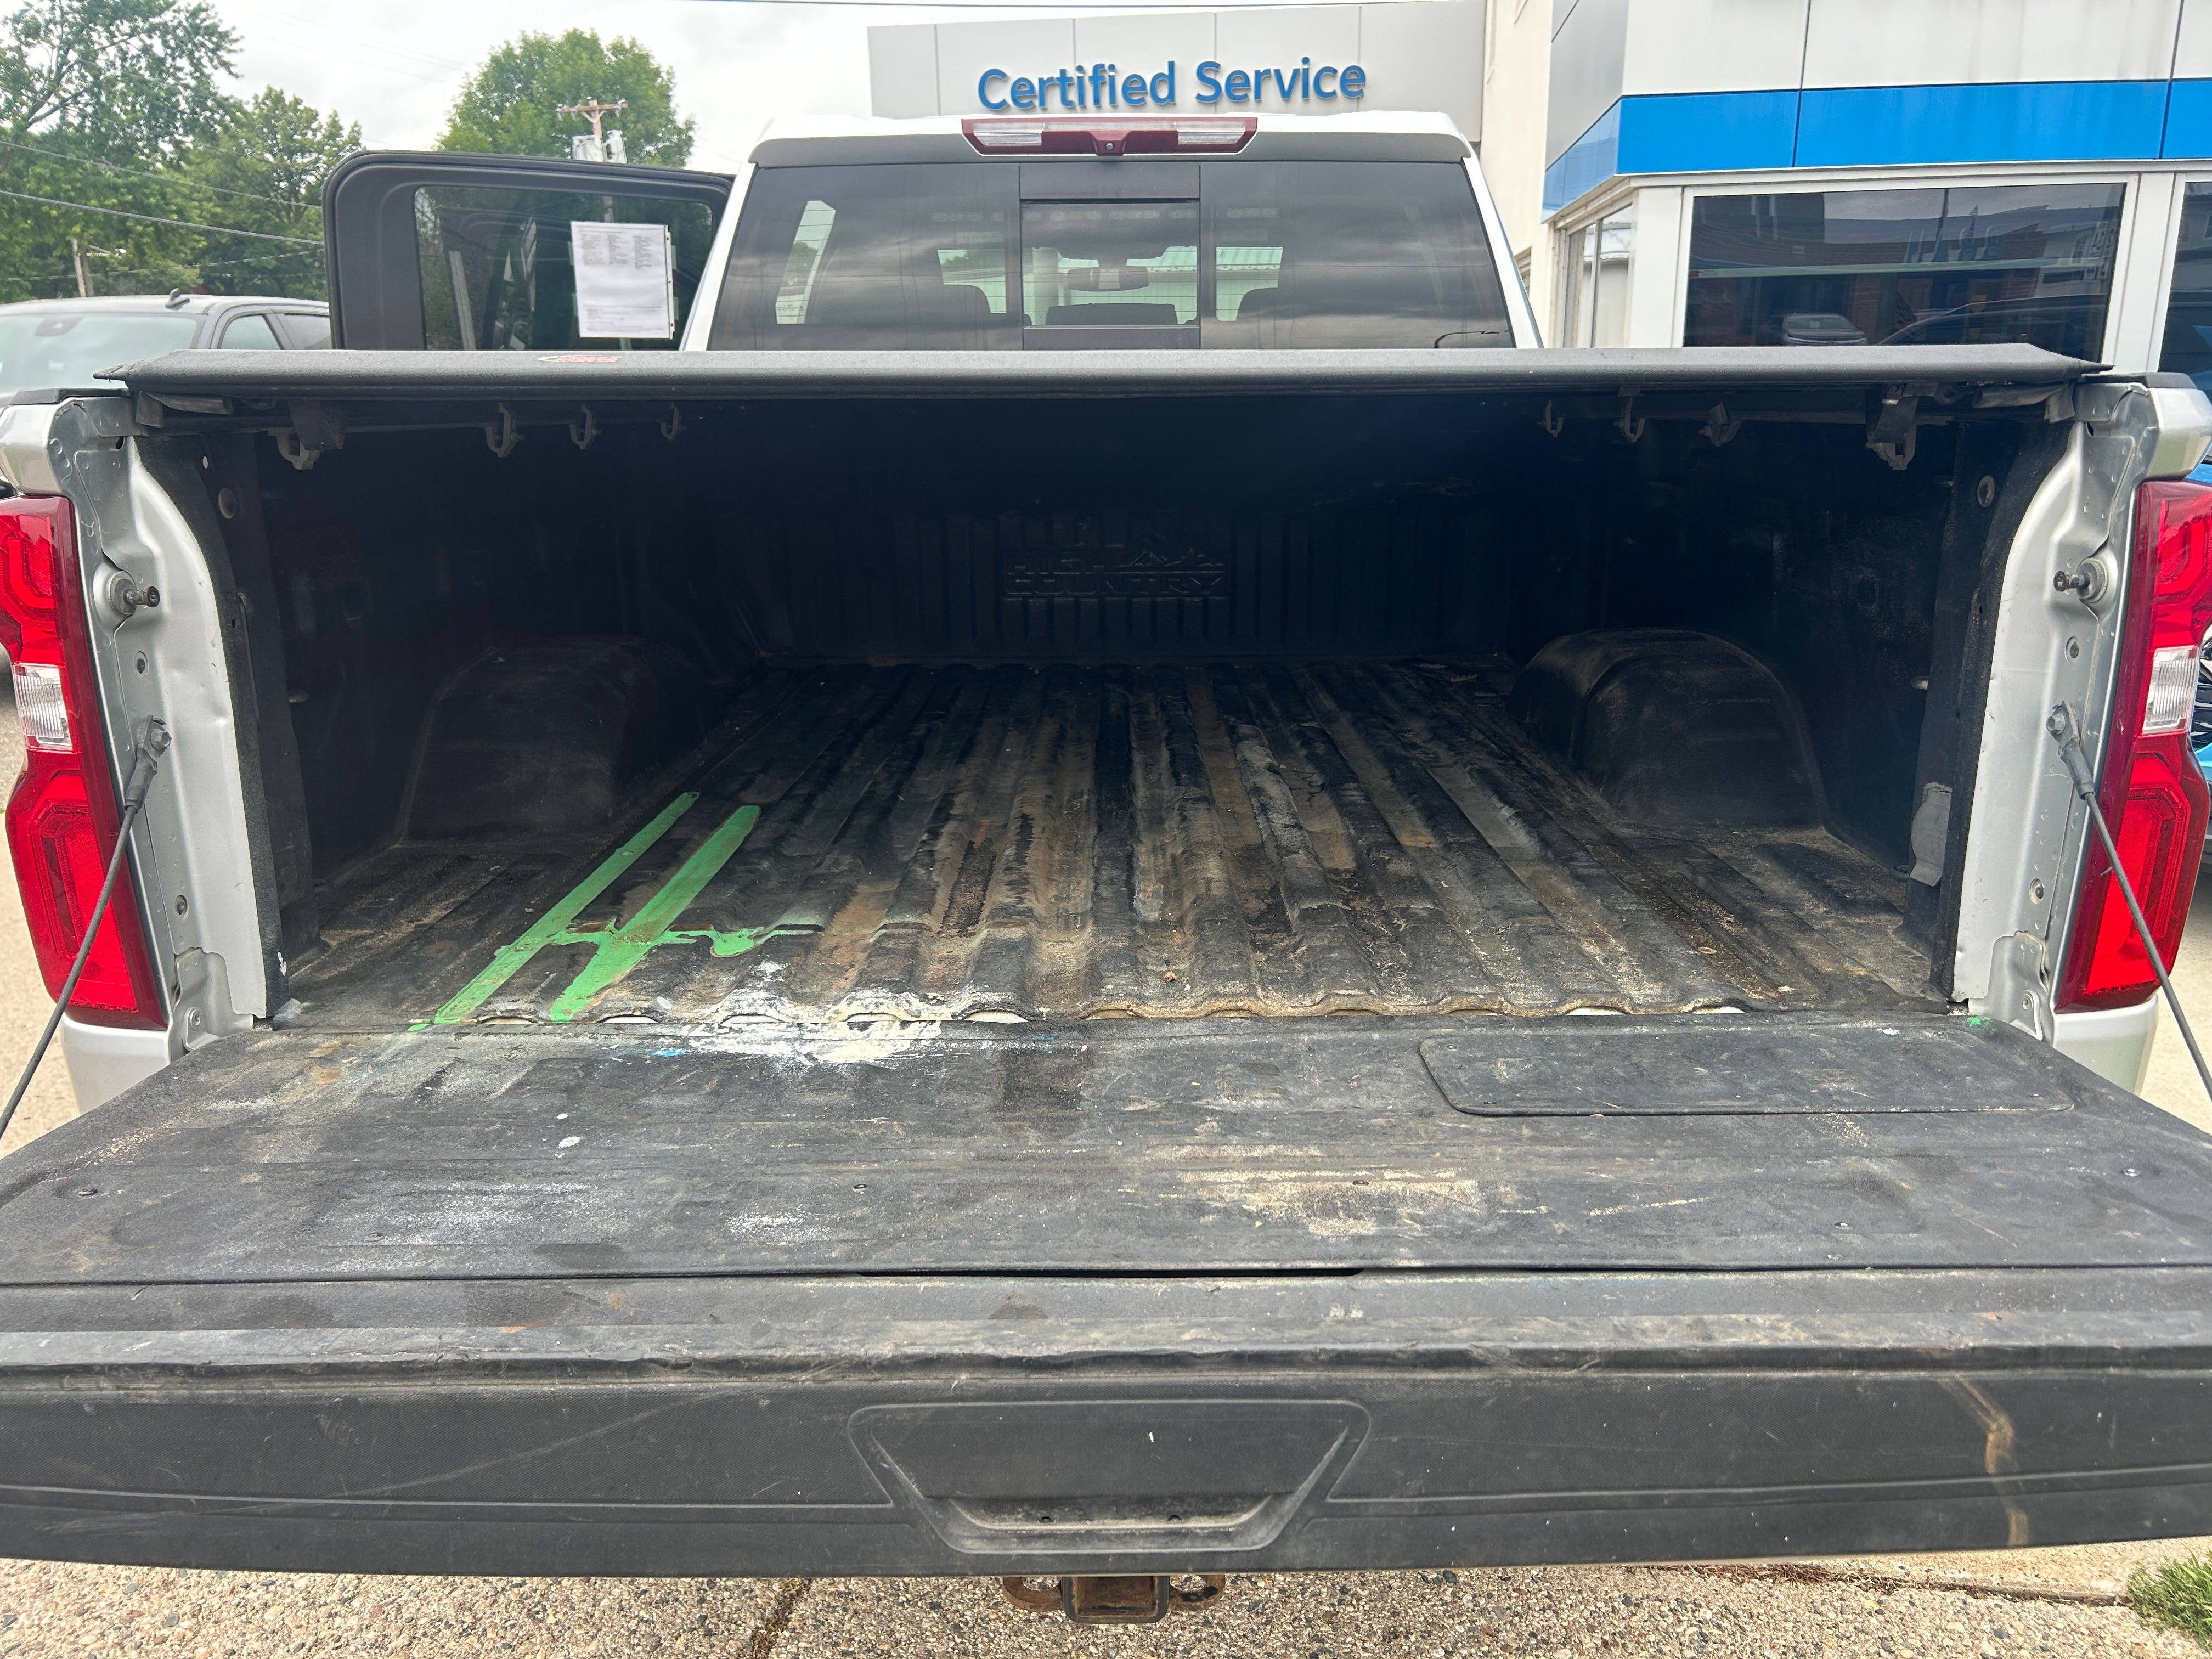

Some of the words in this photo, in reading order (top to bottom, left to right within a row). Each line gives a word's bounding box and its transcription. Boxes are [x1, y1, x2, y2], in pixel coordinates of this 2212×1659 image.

[978, 60, 1176, 110] Certified
[1195, 55, 1367, 104] Service
[1005, 576, 1223, 595] COUNTRY
